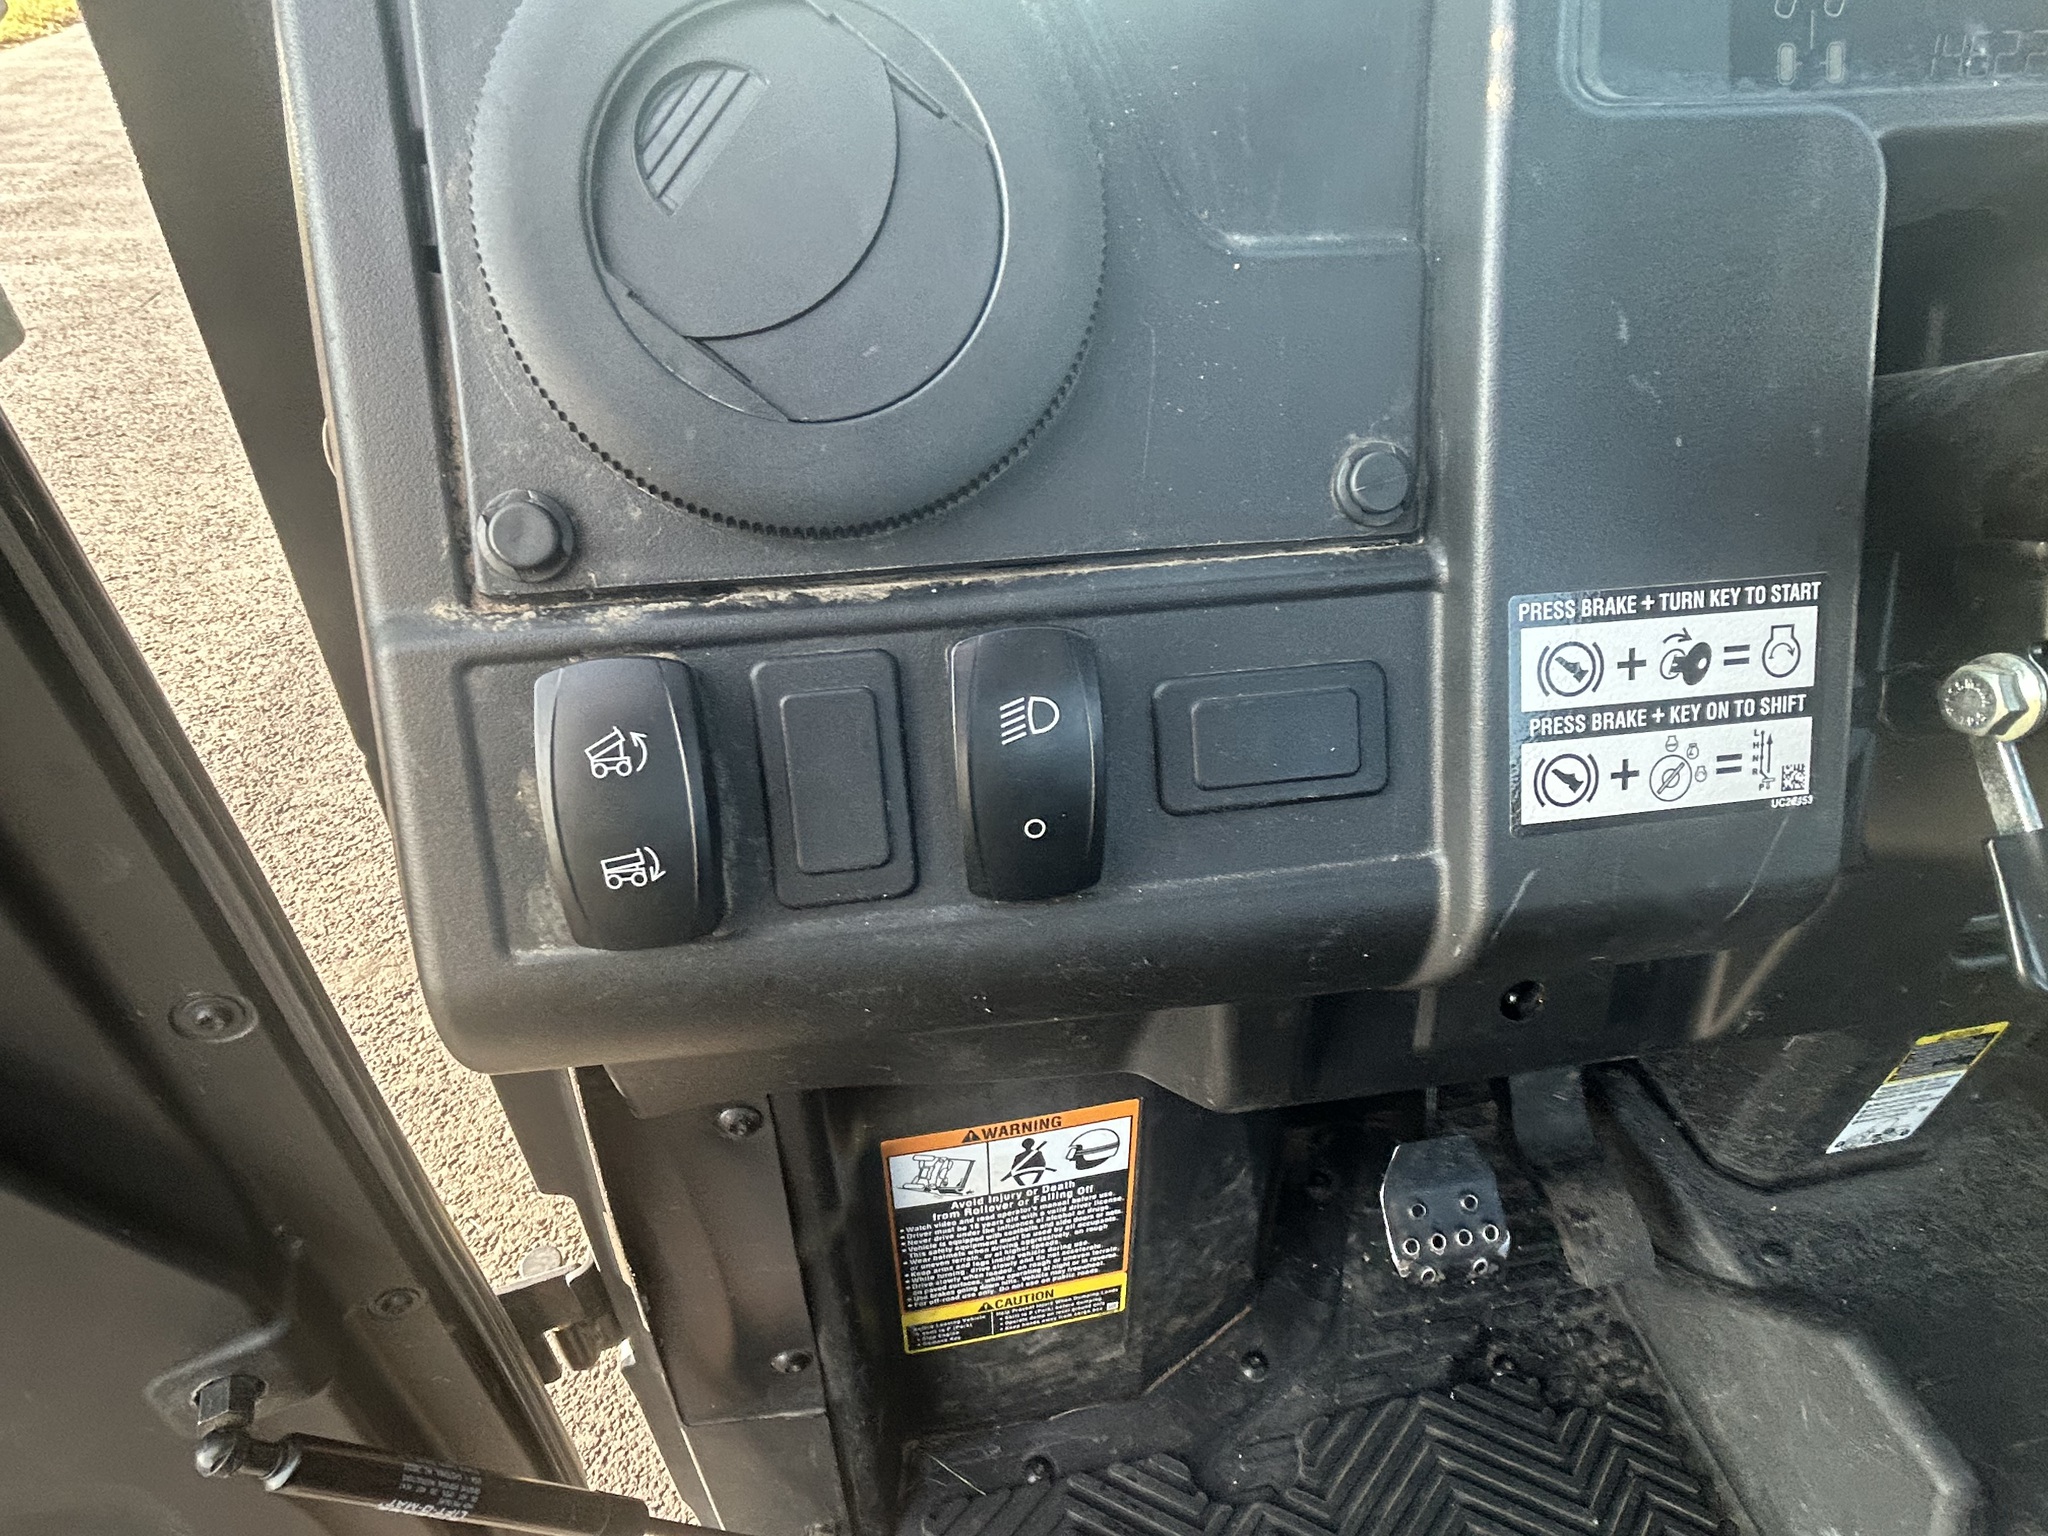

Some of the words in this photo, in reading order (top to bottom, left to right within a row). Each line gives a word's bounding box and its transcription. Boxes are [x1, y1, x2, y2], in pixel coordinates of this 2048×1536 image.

[1518, 599, 1576, 622] PRESS
[1581, 595, 1637, 616] BRAKE
[1659, 591, 1705, 612] TURN
[1709, 588, 1742, 607] KEY
[1744, 586, 1766, 605] TO
[1770, 581, 1822, 603] START
[1529, 713, 1586, 737] PRESS
[1591, 709, 1647, 731] BRAKE
[1669, 705, 1701, 724] KEY
[1706, 702, 1730, 721] ON
[1733, 699, 1756, 718] TO
[1760, 694, 1807, 715] SHIFT
[981, 1115, 1062, 1140] WARNING
[932, 1208, 960, 1221] from
[964, 1199, 1013, 1215] Rollover
[1017, 1197, 1029, 1206] or
[1033, 1188, 1072, 1204] Falling
[1077, 1184, 1093, 1195] Off
[950, 1196, 983, 1209] Avoid
[988, 1189, 1022, 1204] Injury
[1026, 1188, 1038, 1196] or
[1042, 1180, 1075, 1193] Death
[905, 1223, 931, 1233] Watch
[933, 1218, 956, 1228] video
[958, 1215, 974, 1223] and
[976, 1212, 994, 1220] read
[997, 1204, 1037, 1218] operator's
[1039, 1198, 1069, 1209] manual
[1072, 1194, 1096, 1203] before
[906, 1229, 931, 1239] Driver
[934, 1225, 954, 1234] must
[981, 1218, 1003, 1227] years
[1005, 1214, 1018, 1222] old
[1020, 1210, 1037, 1219] with
[1046, 1205, 1066, 1214] valid
[1069, 1201, 1091, 1210] driver
[906, 1237, 930, 1246] Never
[933, 1232, 954, 1241] drive
[956, 1228, 979, 1237] under
[997, 1218, 1033, 1230] influence
[1046, 1211, 1074, 1221] alcohol
[907, 1242, 937, 1252] Vehicle
[948, 1234, 983, 1246] equipped
[985, 1230, 1002, 1238] with
[1055, 1217, 1070, 1225] side
[1073, 1213, 1094, 1222] doors
[928, 1246, 952, 1256] safety
[954, 1237, 997, 1251] equipment
[999, 1233, 1019, 1242] must
[1032, 1228, 1051, 1236] used
[1053, 1225, 1063, 1233] by
[933, 1249, 965, 1260] helmets
[967, 1245, 988, 1254] when
[991, 1240, 1018, 1251] driving
[994, 1289, 1054, 1308] CAUTION
